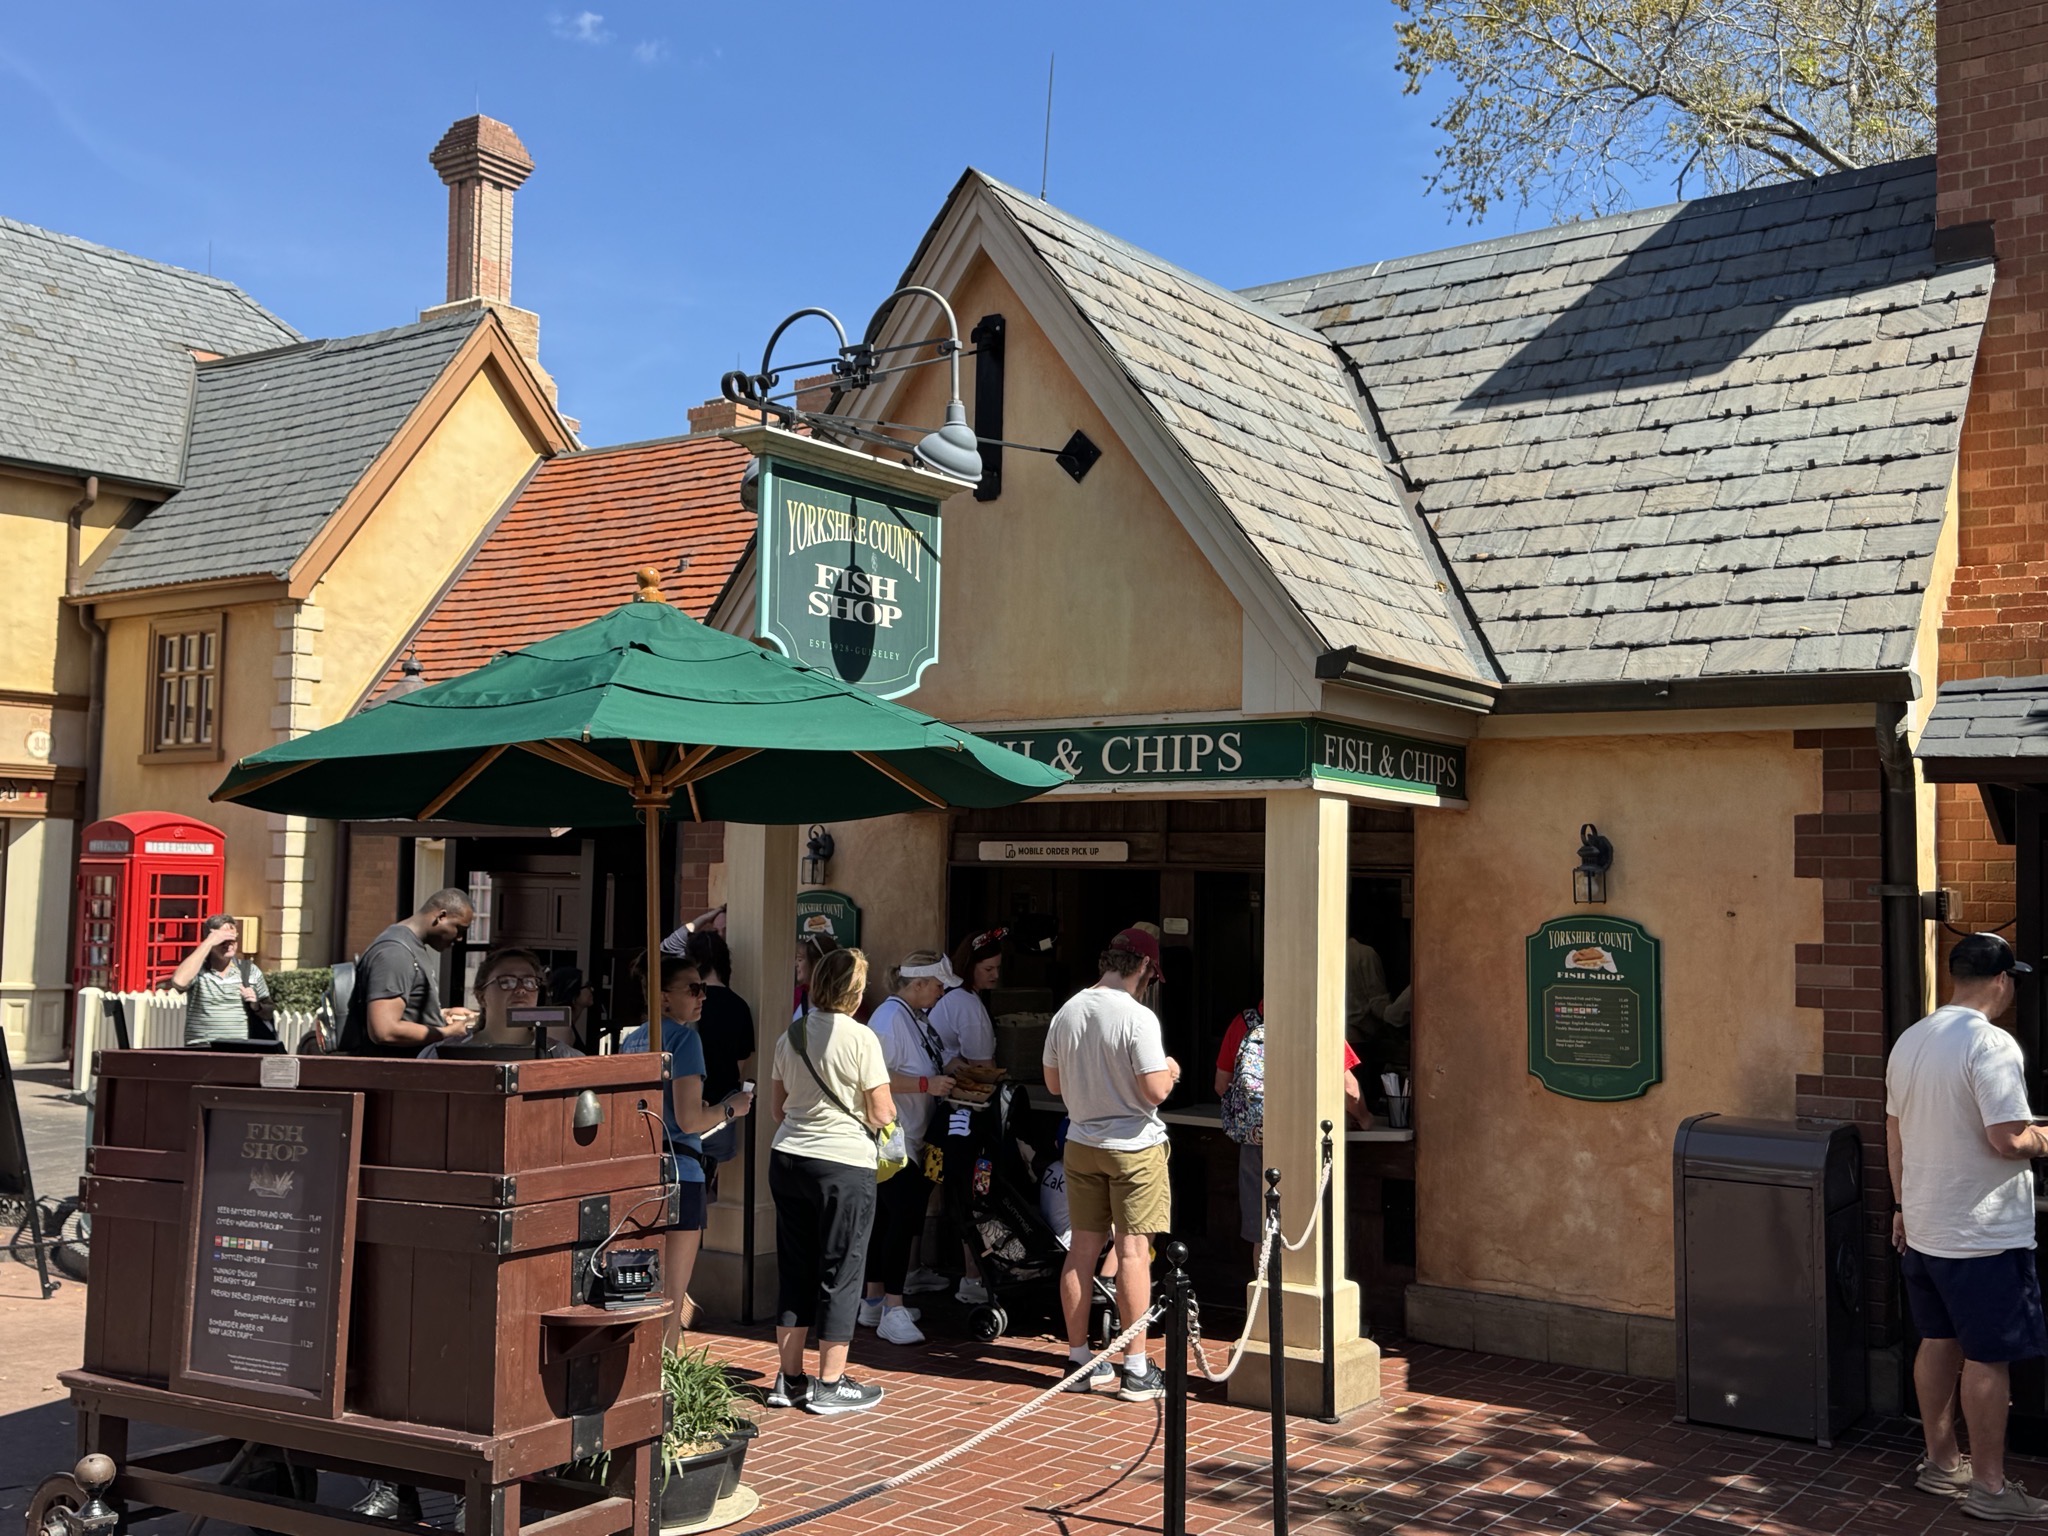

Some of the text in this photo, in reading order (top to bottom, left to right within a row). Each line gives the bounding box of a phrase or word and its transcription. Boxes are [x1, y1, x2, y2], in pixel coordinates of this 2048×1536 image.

[787, 499, 924, 583] YORKSHIRE COUNTY
[815, 563, 898, 602] FISH
[808, 591, 902, 628] SHOP
[809, 638, 827, 650] EST
[1050, 738, 1083, 776] &
[1101, 732, 1242, 775] CHIPS
[1323, 734, 1457, 788] FISH & CHIPS
[1018, 847, 1100, 856] MOBILE ORDER PICK UP
[797, 903, 845, 920] ORKSHIRE COUNTY
[1548, 930, 1633, 953] YORKSHIRE COUNTY
[1557, 971, 1625, 982] FISH SHOP
[246, 1122, 304, 1143] FISH
[241, 1142, 308, 1162] SHOP
[1043, 1168, 1065, 1193] Zak
